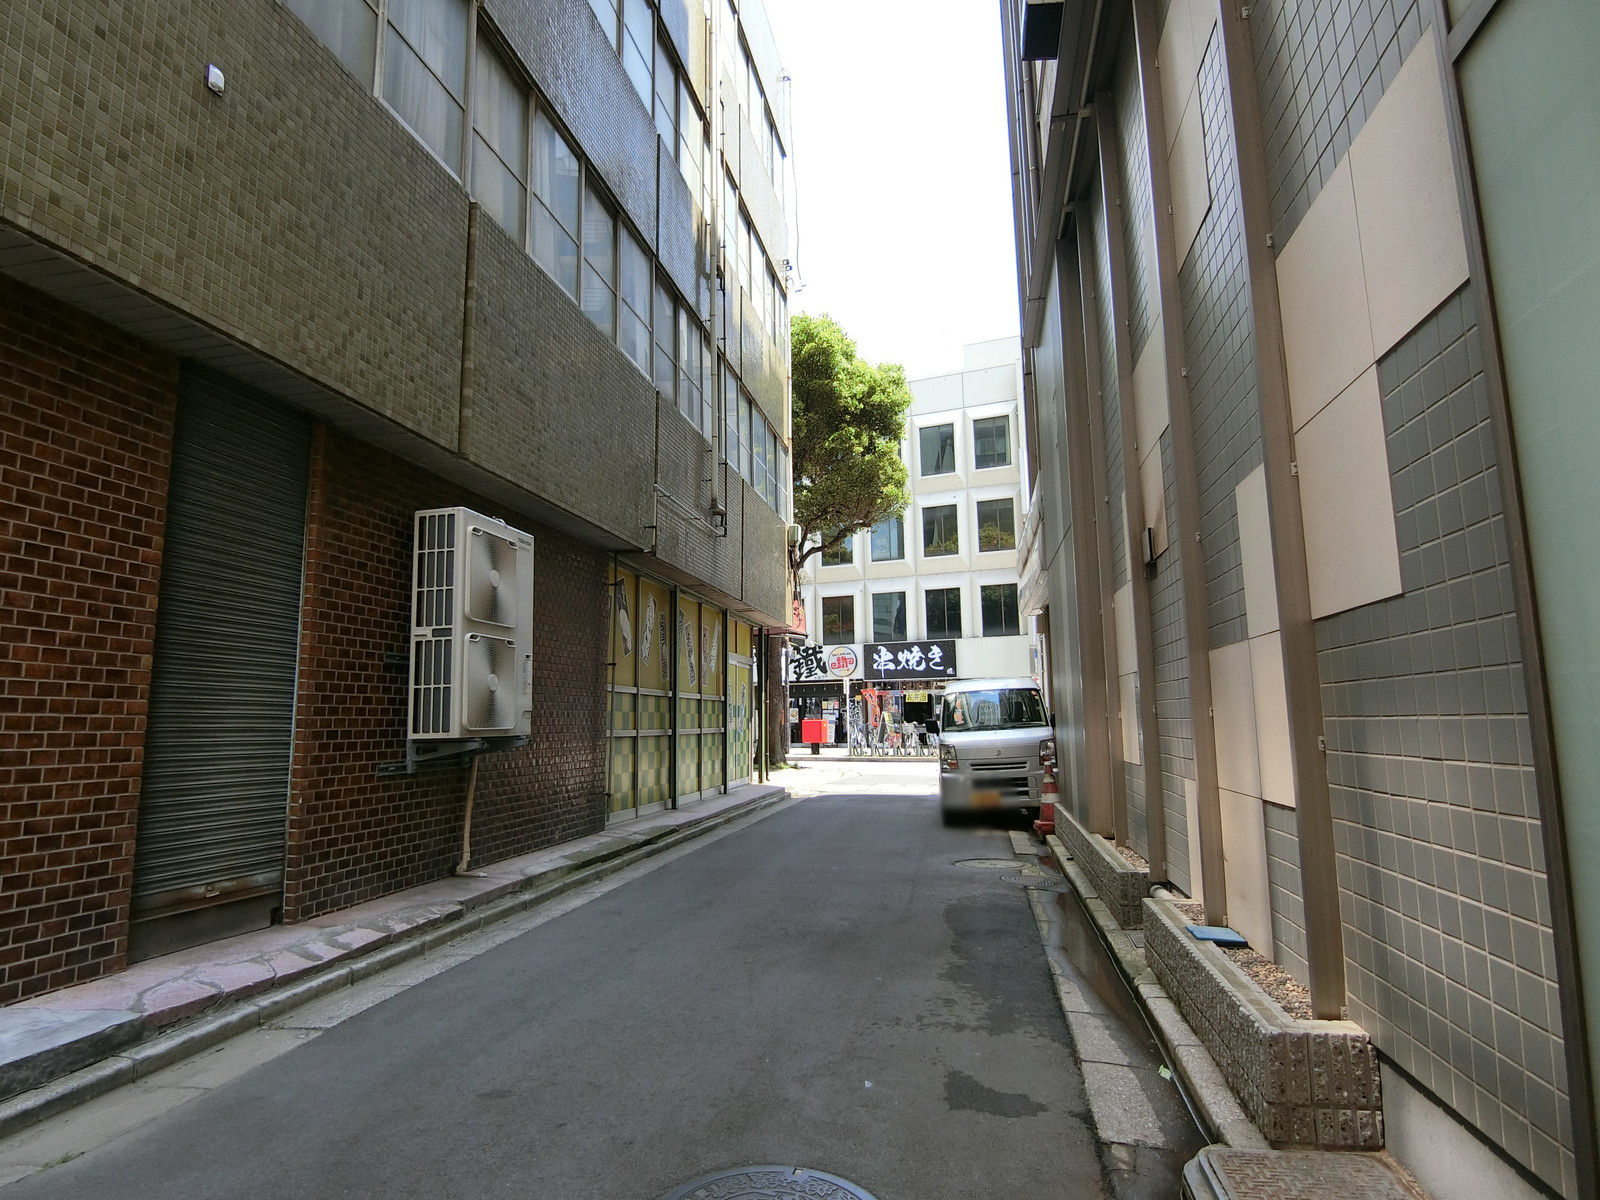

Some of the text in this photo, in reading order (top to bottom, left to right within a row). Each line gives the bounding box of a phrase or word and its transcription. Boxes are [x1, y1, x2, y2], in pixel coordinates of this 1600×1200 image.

[872, 644, 944, 679] 串焼き
[906, 692, 927, 702] お弁当
